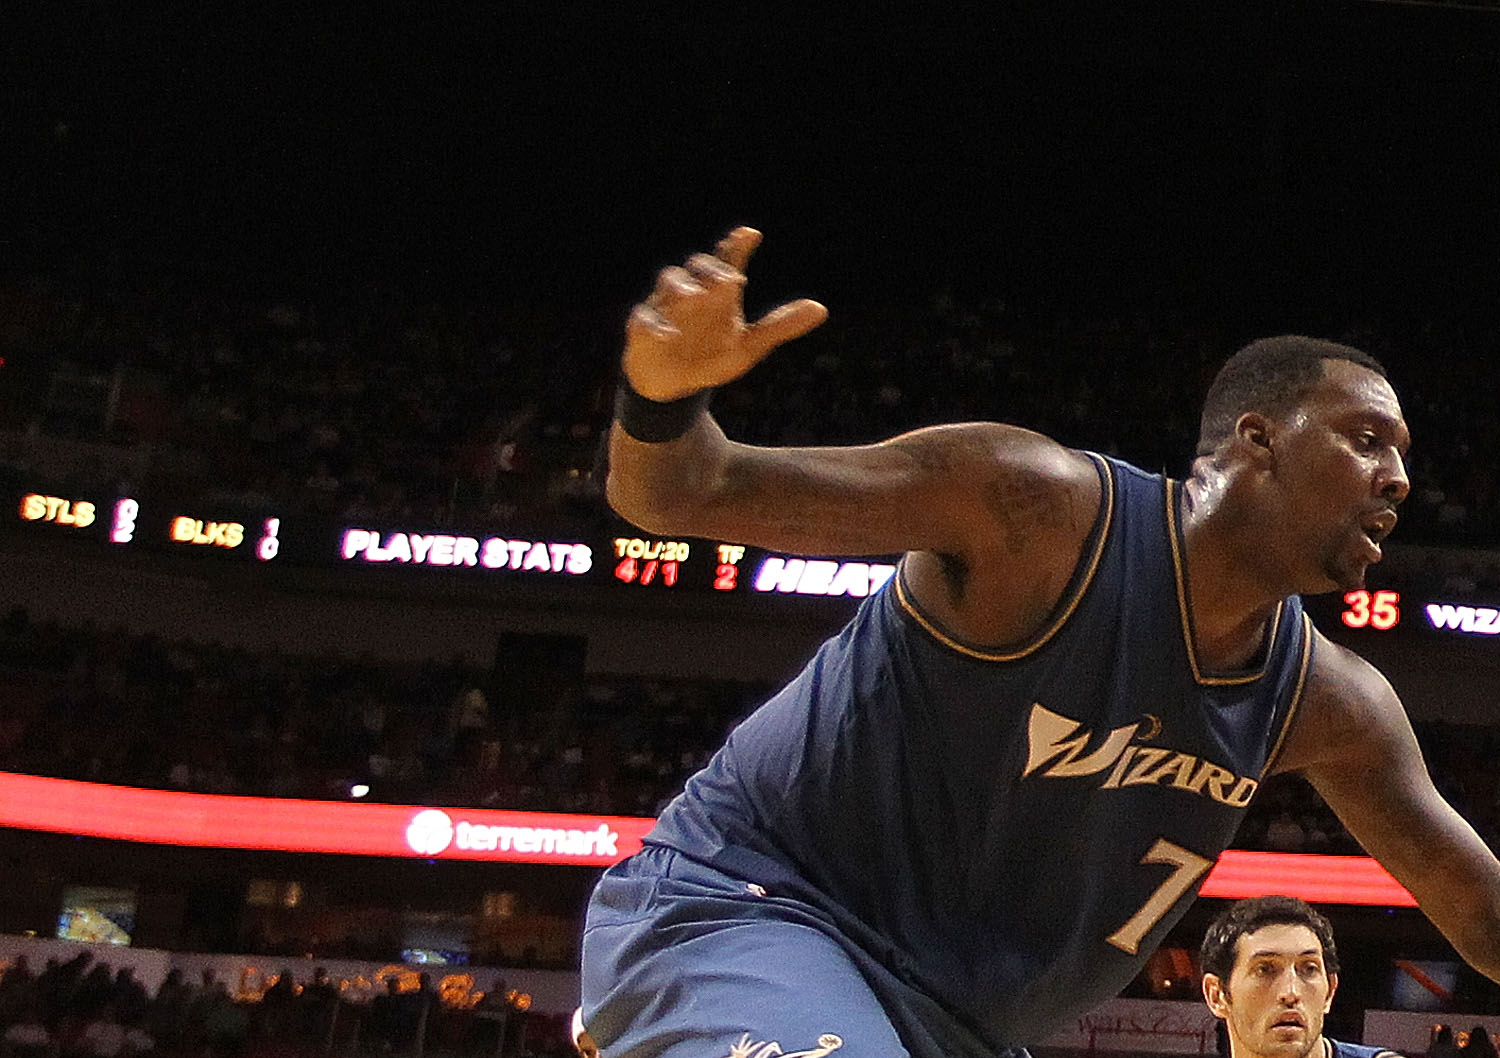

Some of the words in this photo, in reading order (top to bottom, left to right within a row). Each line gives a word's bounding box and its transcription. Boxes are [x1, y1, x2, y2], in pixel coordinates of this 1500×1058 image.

[20, 493, 96, 528] STLS
[170, 516, 245, 549] BLKS
[341, 529, 478, 567] PLAYER
[481, 537, 593, 575] STATS
[717, 544, 746, 565] TF
[713, 564, 738, 592] 2
[754, 556, 898, 598] HEAT
[1342, 590, 1399, 630] 35
[455, 820, 618, 857] terremark
[1105, 838, 1216, 954] 7
